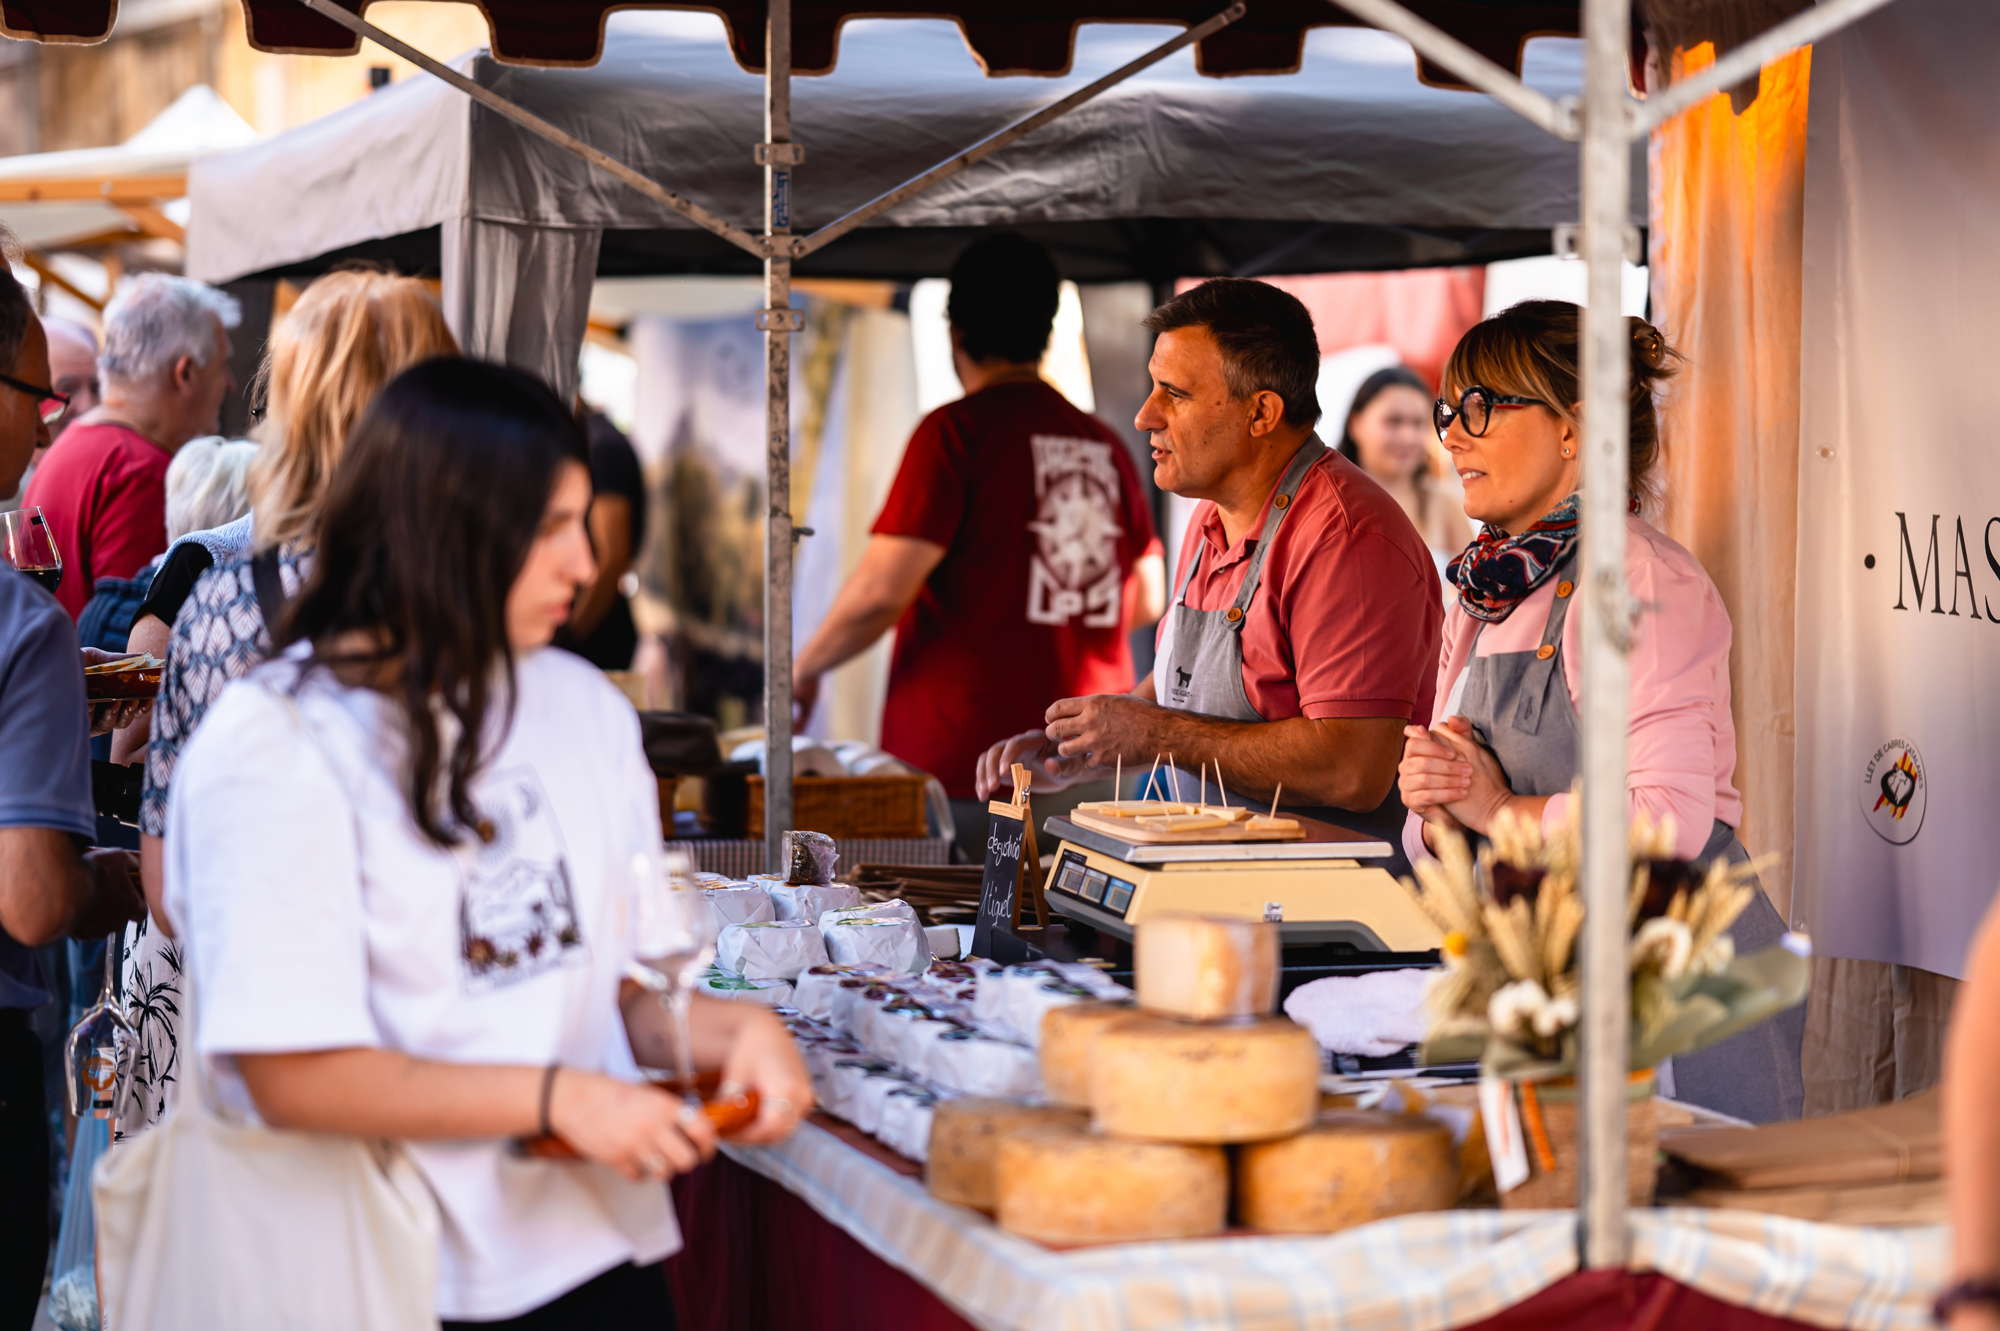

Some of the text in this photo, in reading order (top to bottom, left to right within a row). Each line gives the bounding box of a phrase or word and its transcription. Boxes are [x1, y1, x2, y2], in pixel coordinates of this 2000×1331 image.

[1893, 511, 2000, 624] MAS
[1864, 739, 1923, 789] LLET DE CABRES CATALANES
